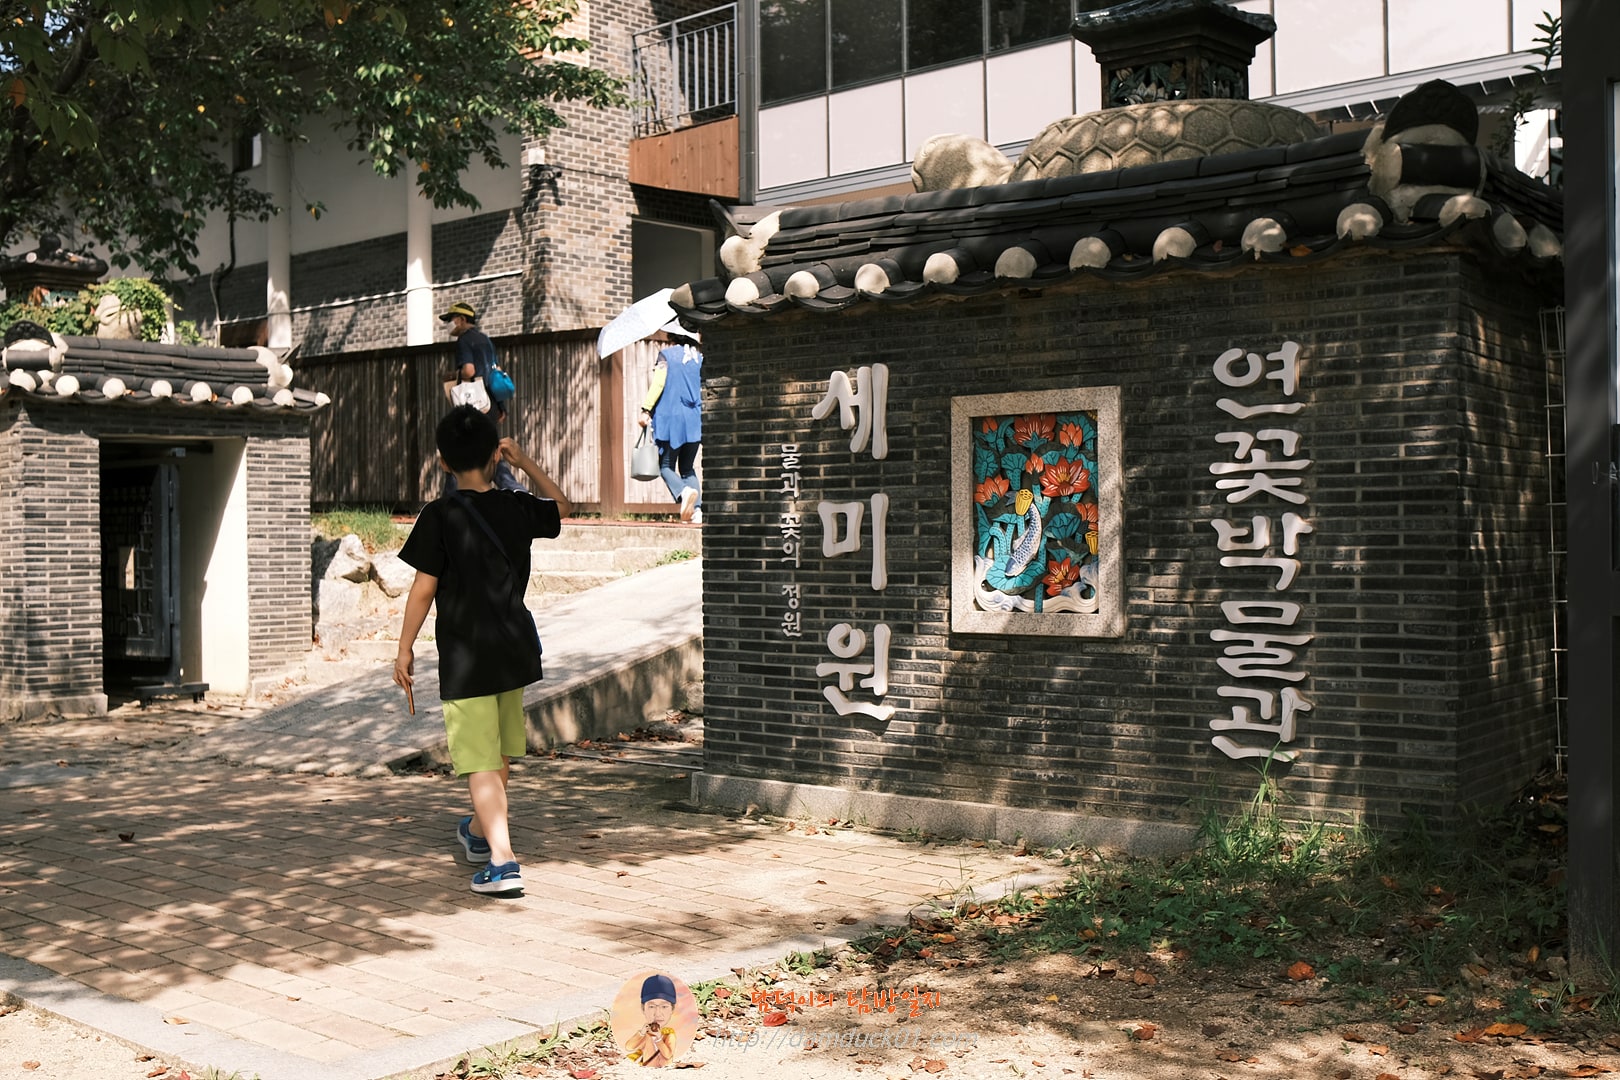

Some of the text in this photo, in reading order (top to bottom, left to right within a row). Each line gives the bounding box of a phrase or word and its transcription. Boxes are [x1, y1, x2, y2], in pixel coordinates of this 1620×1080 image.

[780, 444, 801, 637] 물과 꽃의 정원
[812, 363, 895, 721] 세미원
